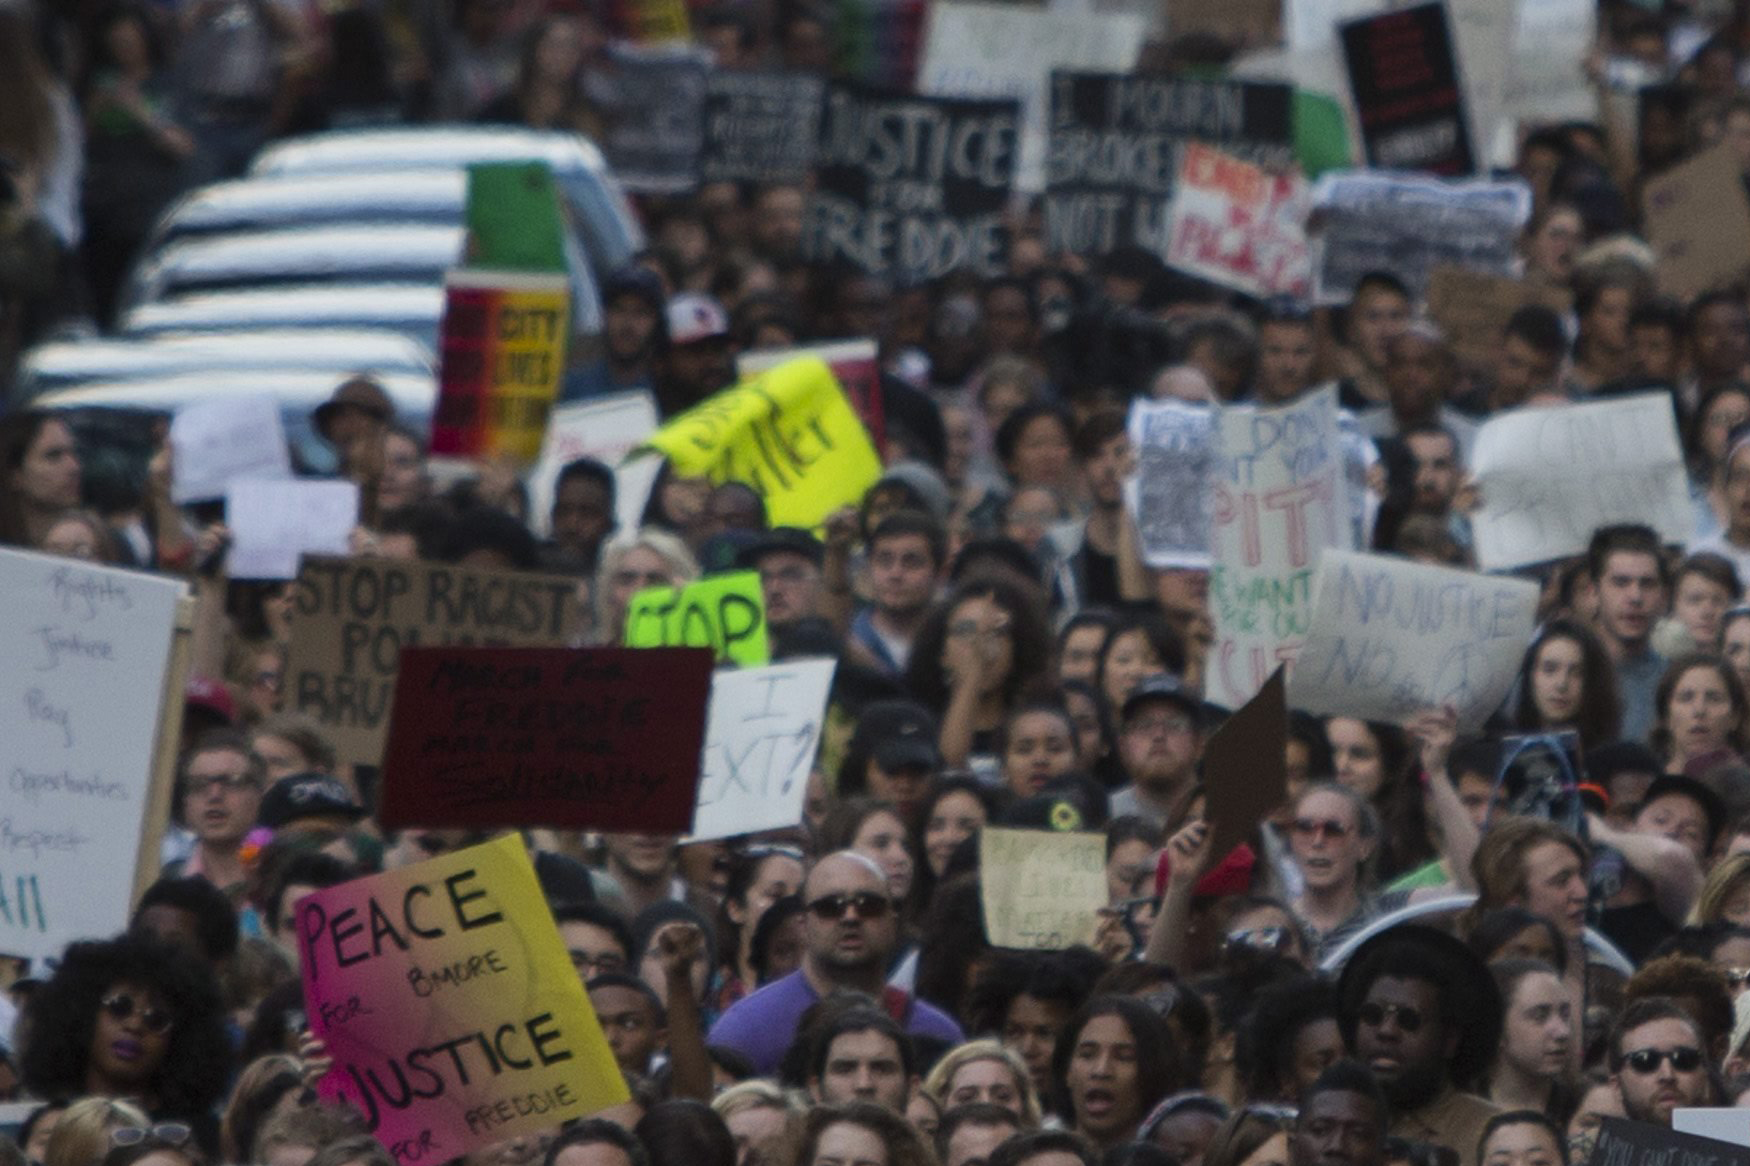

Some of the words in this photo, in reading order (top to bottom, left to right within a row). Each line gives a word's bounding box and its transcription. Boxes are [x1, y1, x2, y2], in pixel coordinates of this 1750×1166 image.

[822, 92, 1015, 189] JUSTICE
[805, 192, 1010, 279] FREDDIE
[296, 562, 412, 619] STOP
[427, 571, 578, 636] RACIST
[305, 868, 503, 980] PEACE
[320, 995, 373, 1033] FOR
[408, 949, 509, 999] BMORE
[344, 1013, 574, 1132] JUSTICE
[391, 1129, 440, 1161] FOR
[466, 1084, 577, 1137] FREDDIE
